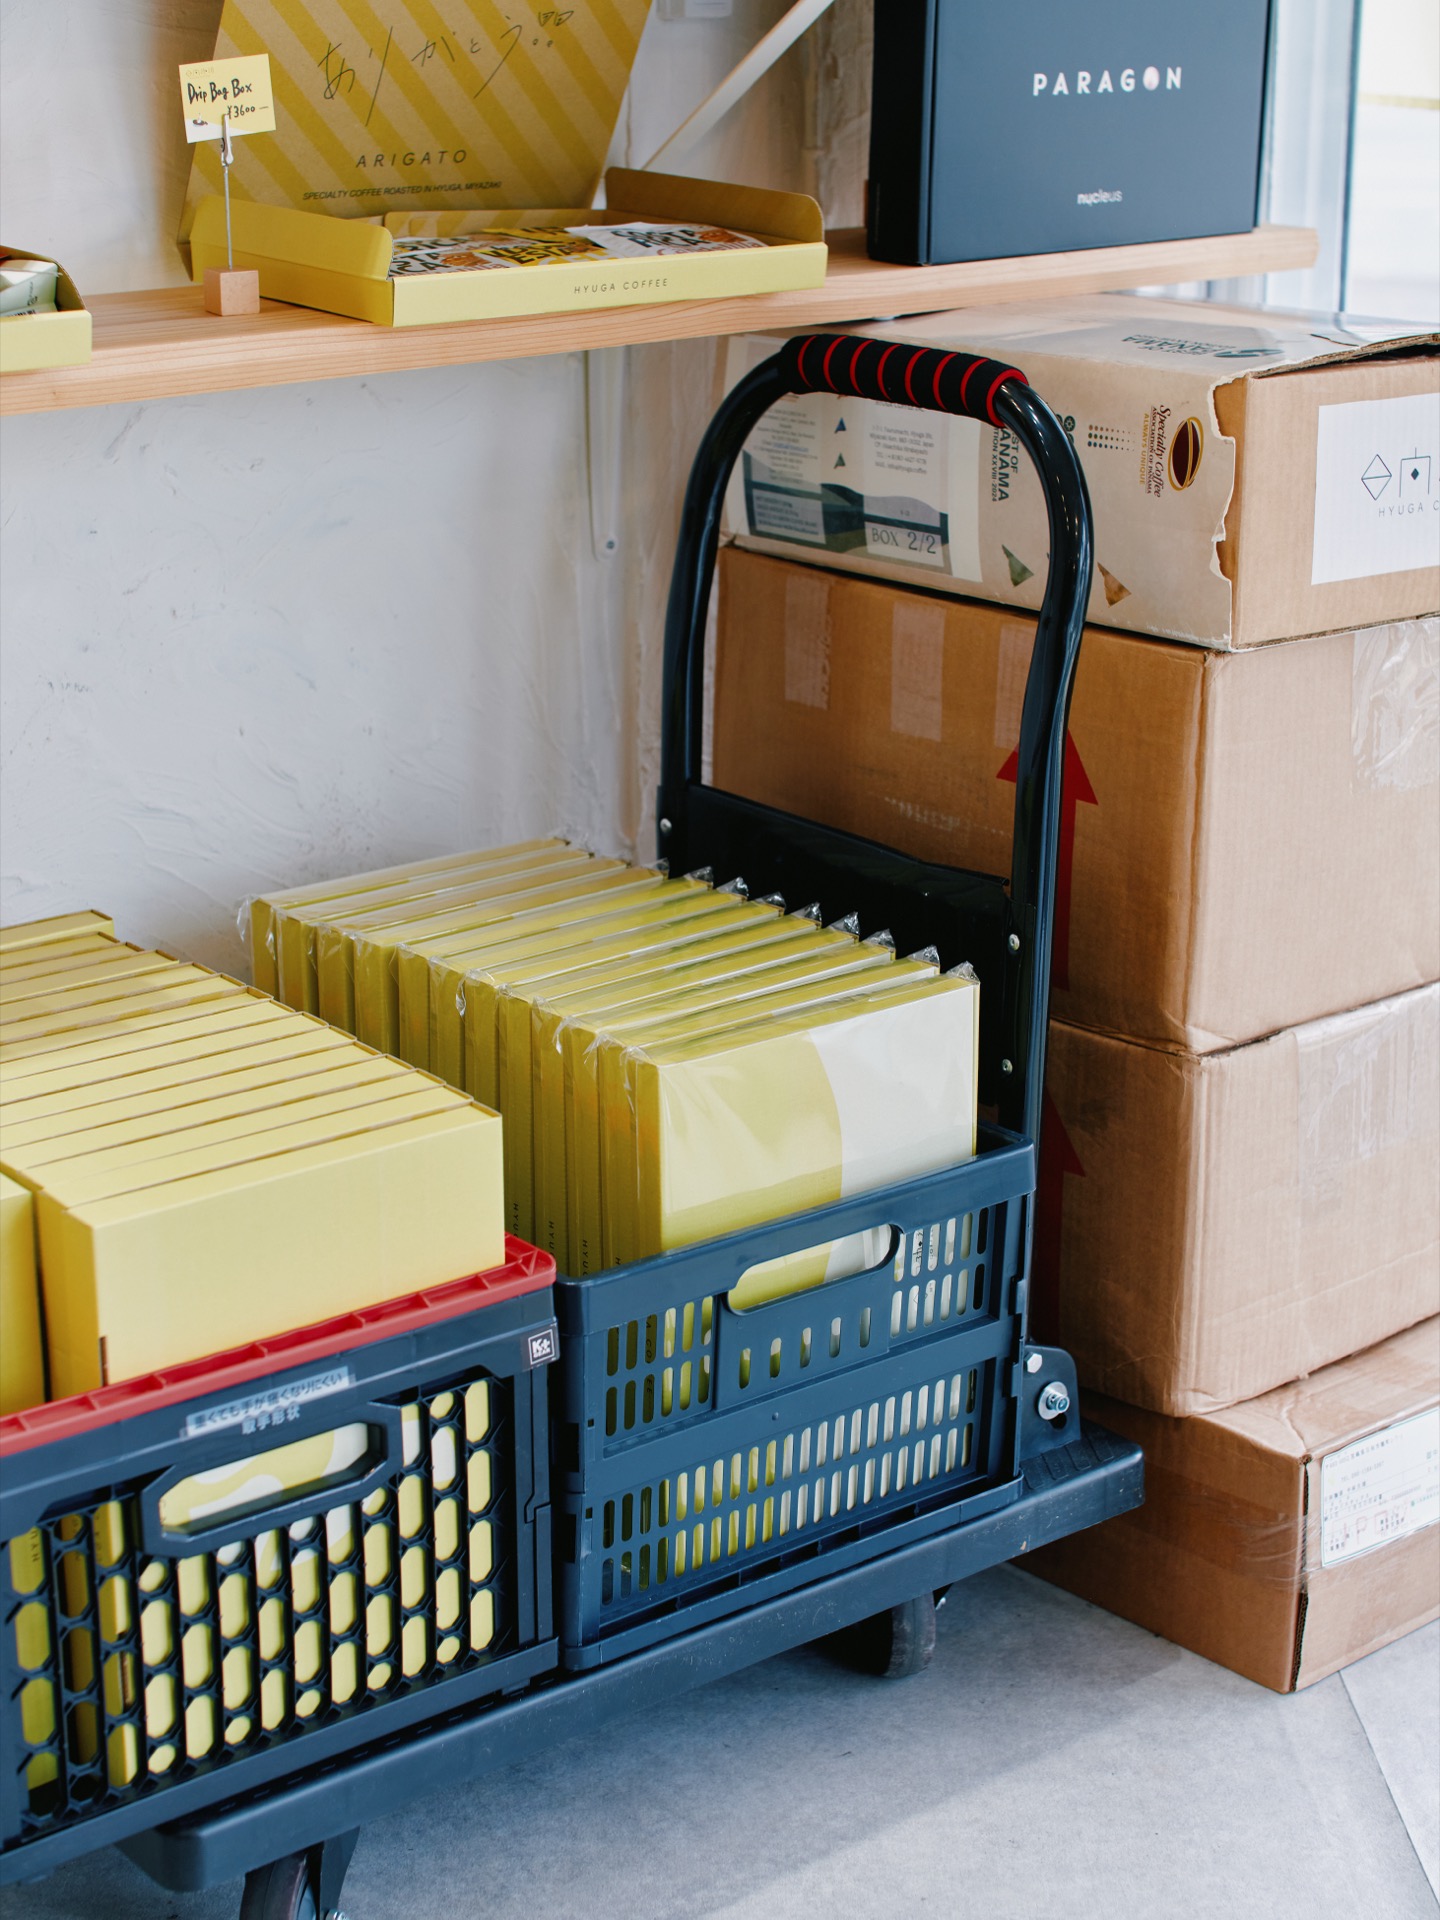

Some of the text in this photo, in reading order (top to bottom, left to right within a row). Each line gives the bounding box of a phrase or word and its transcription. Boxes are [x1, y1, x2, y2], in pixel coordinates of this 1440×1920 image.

[187, 78, 253, 104] Drip Bag Box
[1033, 66, 1182, 96] PARAGON
[356, 149, 467, 168] ARIGATO
[303, 188, 348, 200] SPECIALTY
[349, 187, 383, 198] COFFEE
[383, 185, 422, 196] ROASTED
[423, 184, 432, 193] IN
[464, 181, 502, 191] MIYAZAKI
[1077, 189, 1122, 206] nucleus
[573, 278, 669, 294] HYUGA COFFEE
[1149, 406, 1157, 453] ASSOCIATION
[1139, 413, 1150, 485] ALWAYS UNIQUE
[1152, 404, 1172, 498] Specialty Coffee
[998, 428, 1011, 501] ANAMA
[1010, 455, 1019, 474] OF
[1378, 502, 1424, 518] HYUGA
[871, 527, 936, 555] BOX 2/2
